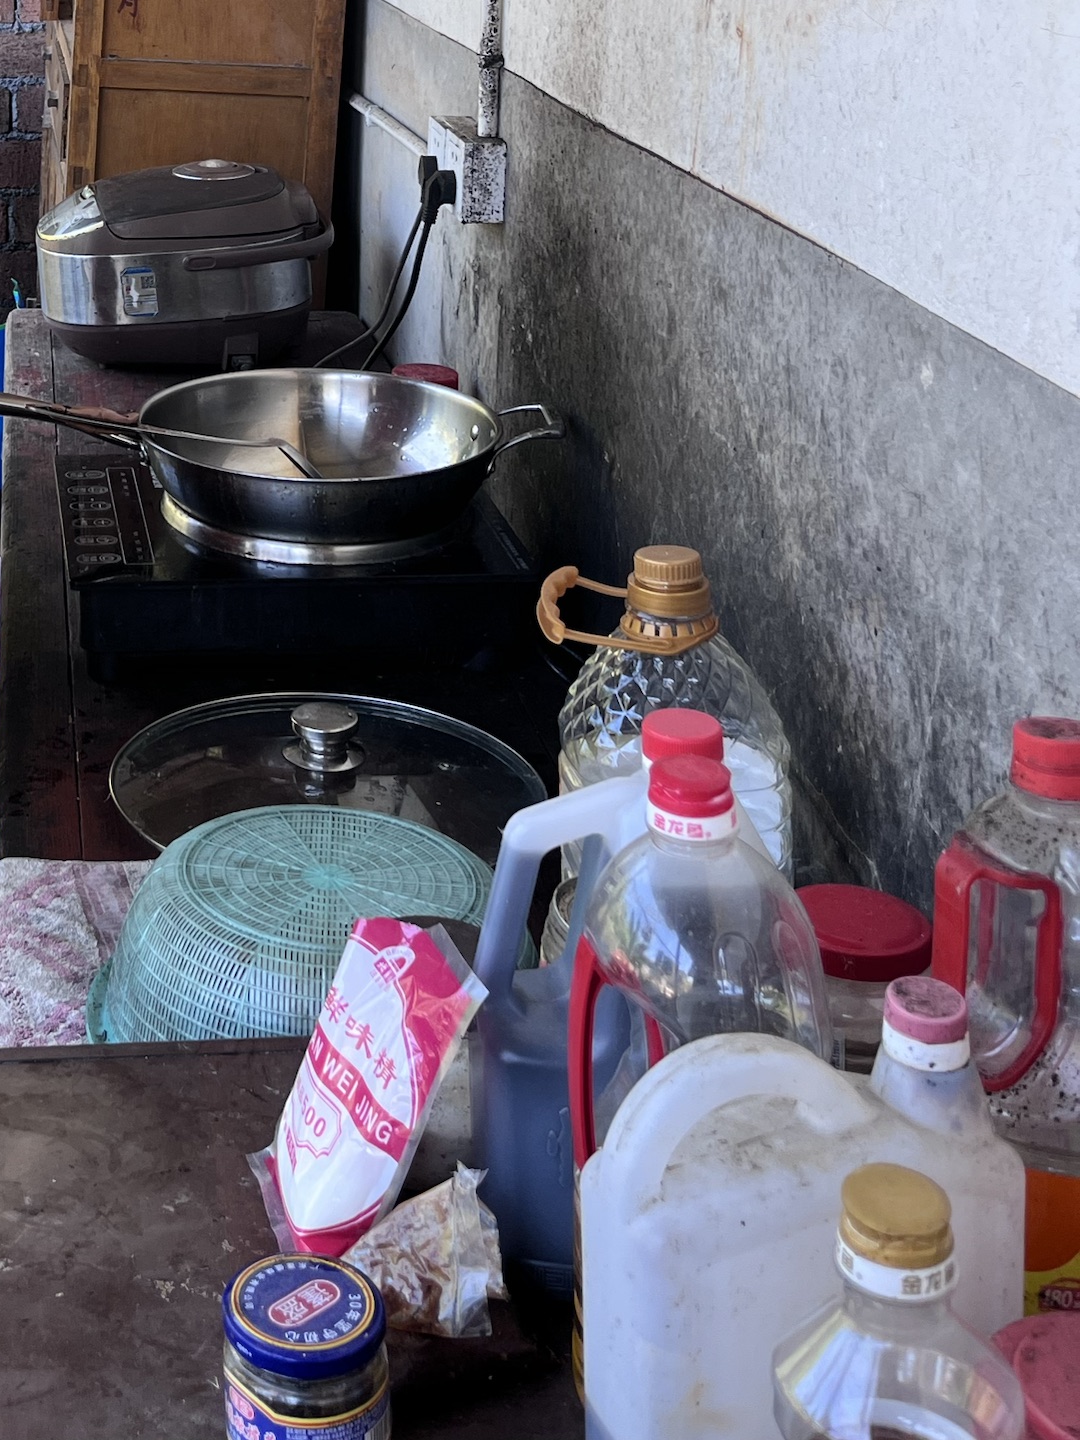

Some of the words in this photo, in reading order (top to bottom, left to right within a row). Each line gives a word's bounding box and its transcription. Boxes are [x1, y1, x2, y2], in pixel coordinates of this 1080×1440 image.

[324, 986, 398, 1090] 鲜味精
[322, 1057, 360, 1100] WEI
[354, 1095, 394, 1146] JING
